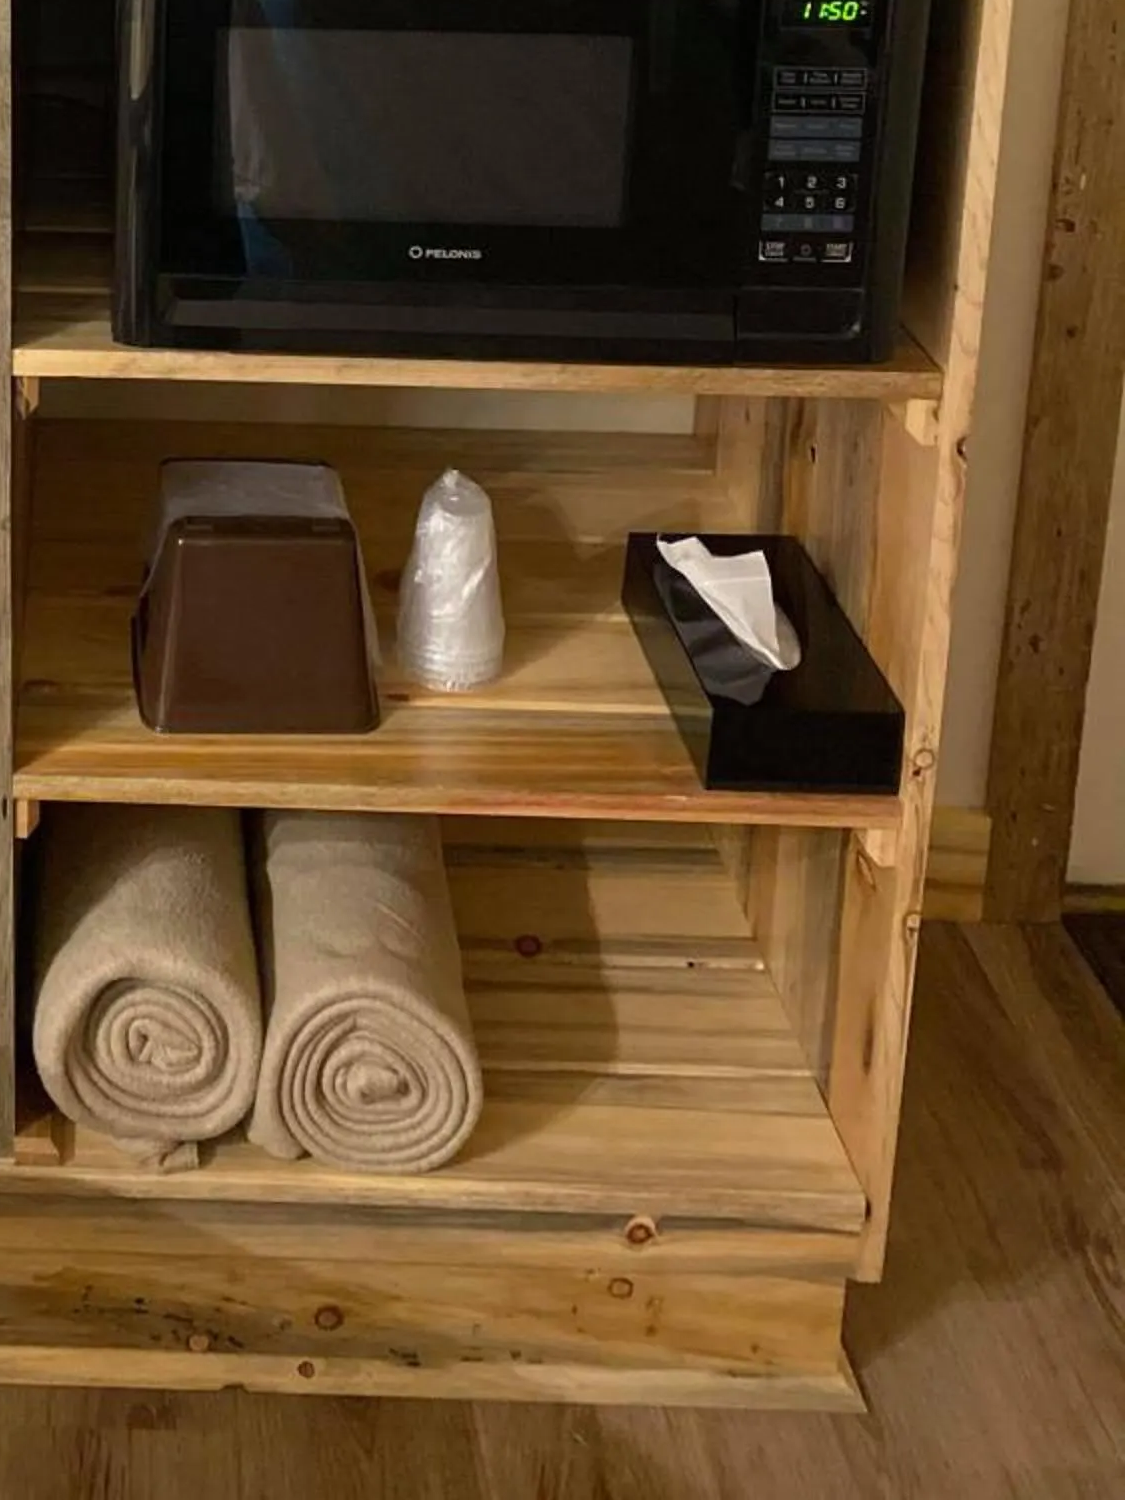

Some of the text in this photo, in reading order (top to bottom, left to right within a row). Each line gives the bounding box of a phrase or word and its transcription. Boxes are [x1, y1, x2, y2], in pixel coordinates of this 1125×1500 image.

[803, 1, 860, 21] 11:50
[806, 175, 818, 189] 2
[835, 176, 847, 190] 3
